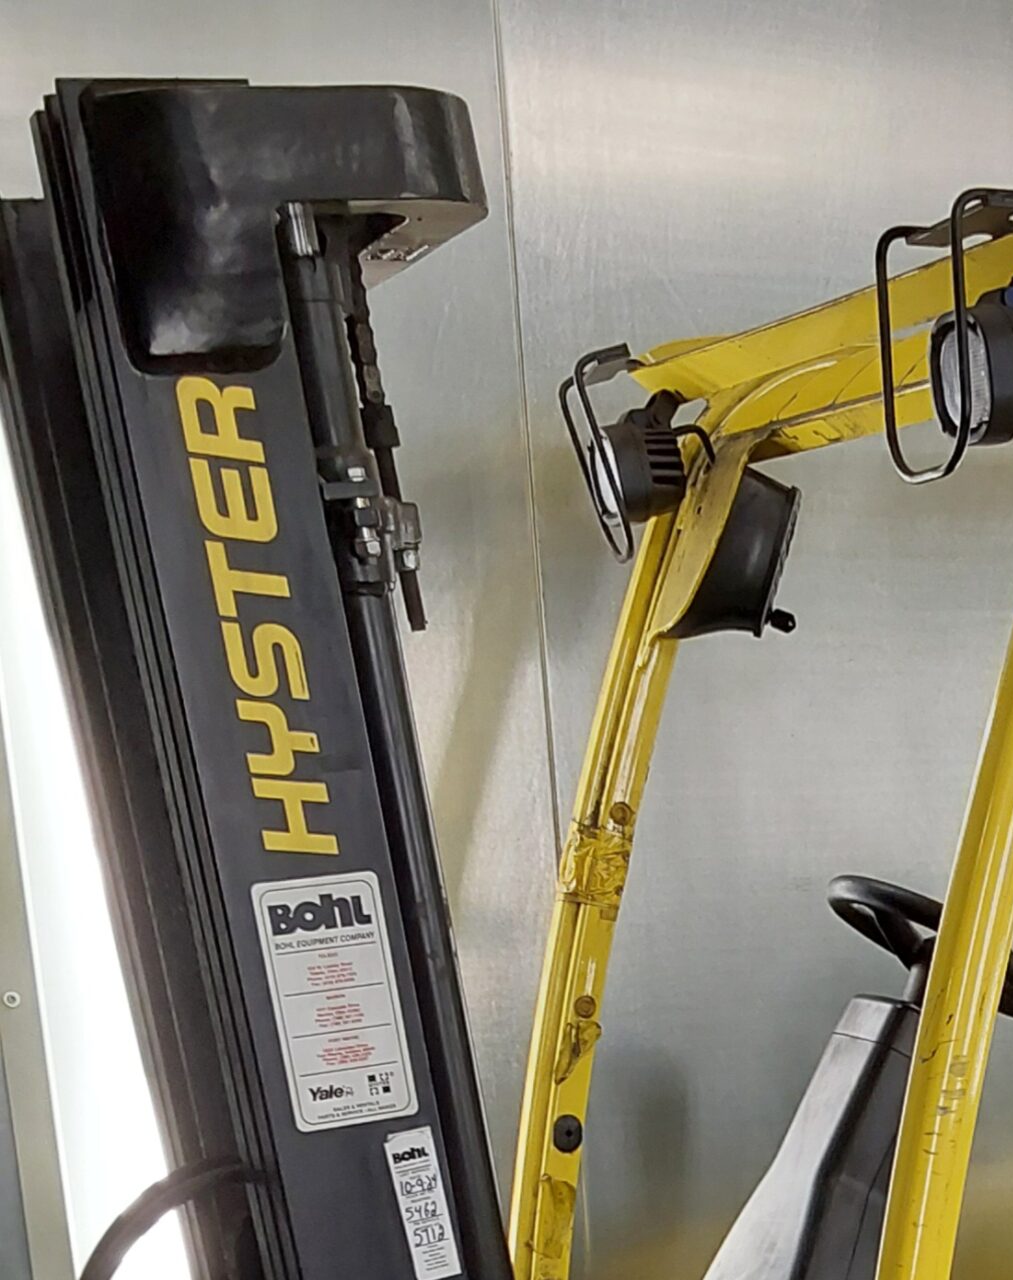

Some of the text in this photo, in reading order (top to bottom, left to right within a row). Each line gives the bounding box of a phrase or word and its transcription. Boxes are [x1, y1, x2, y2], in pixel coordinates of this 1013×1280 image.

[175, 374, 341, 856] HYSTER
[274, 931, 375, 951] BOHL EQUIPMENT COMPANY
[308, 1083, 345, 1102] Yale
[404, 1200, 438, 1221] 5462
